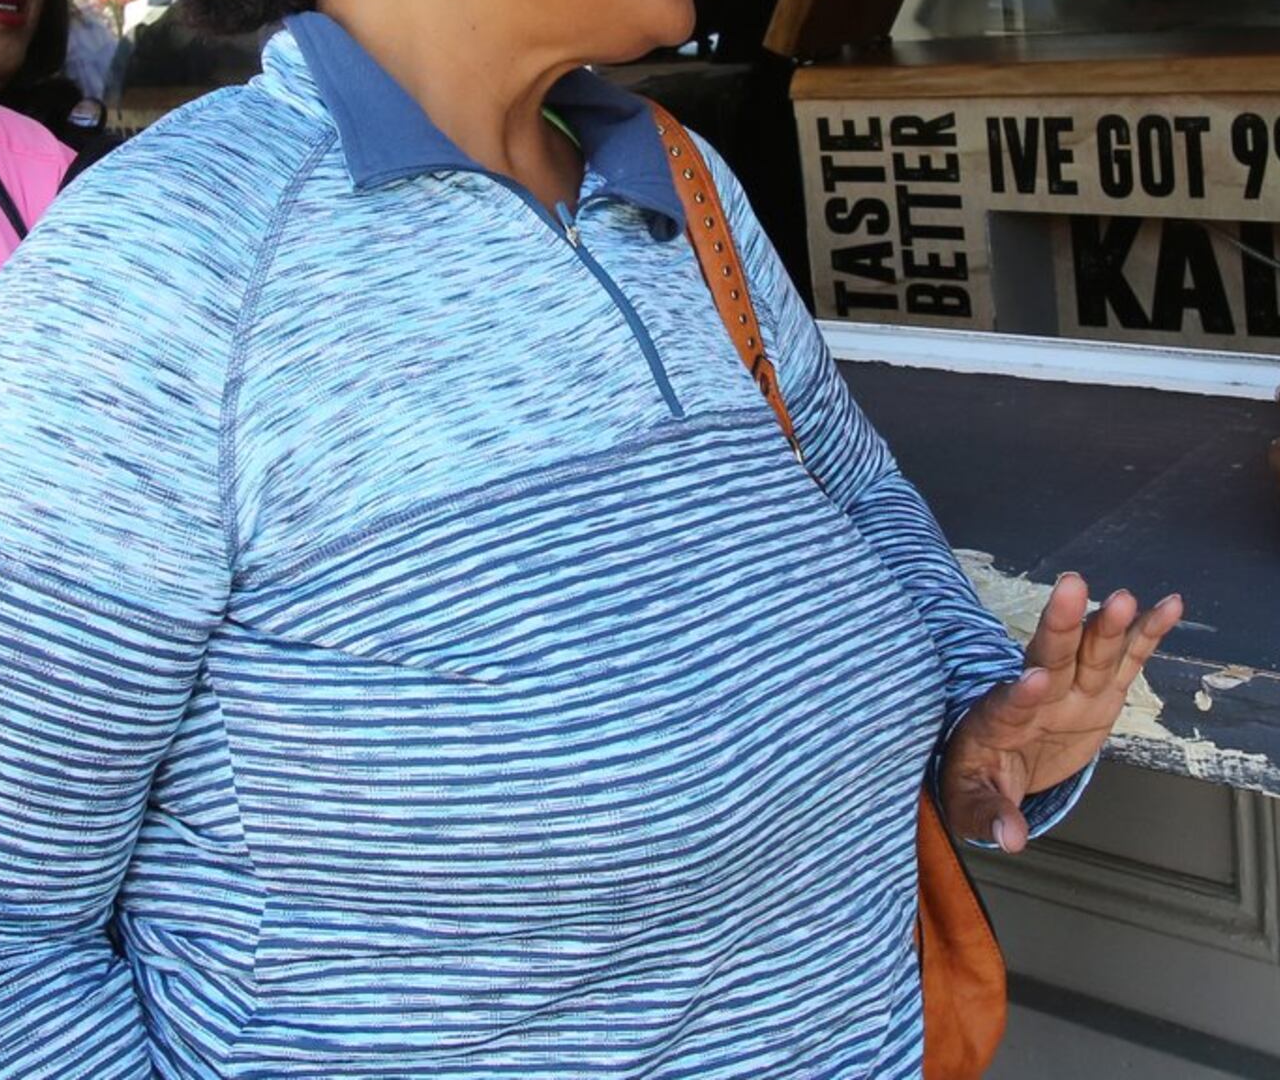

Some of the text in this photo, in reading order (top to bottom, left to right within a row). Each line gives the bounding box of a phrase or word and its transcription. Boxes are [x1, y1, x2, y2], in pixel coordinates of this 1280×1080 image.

[817, 116, 899, 317] TASTE
[890, 111, 972, 318] BETTER
[986, 116, 1079, 196] IVE
[1096, 113, 1211, 199] GOT
